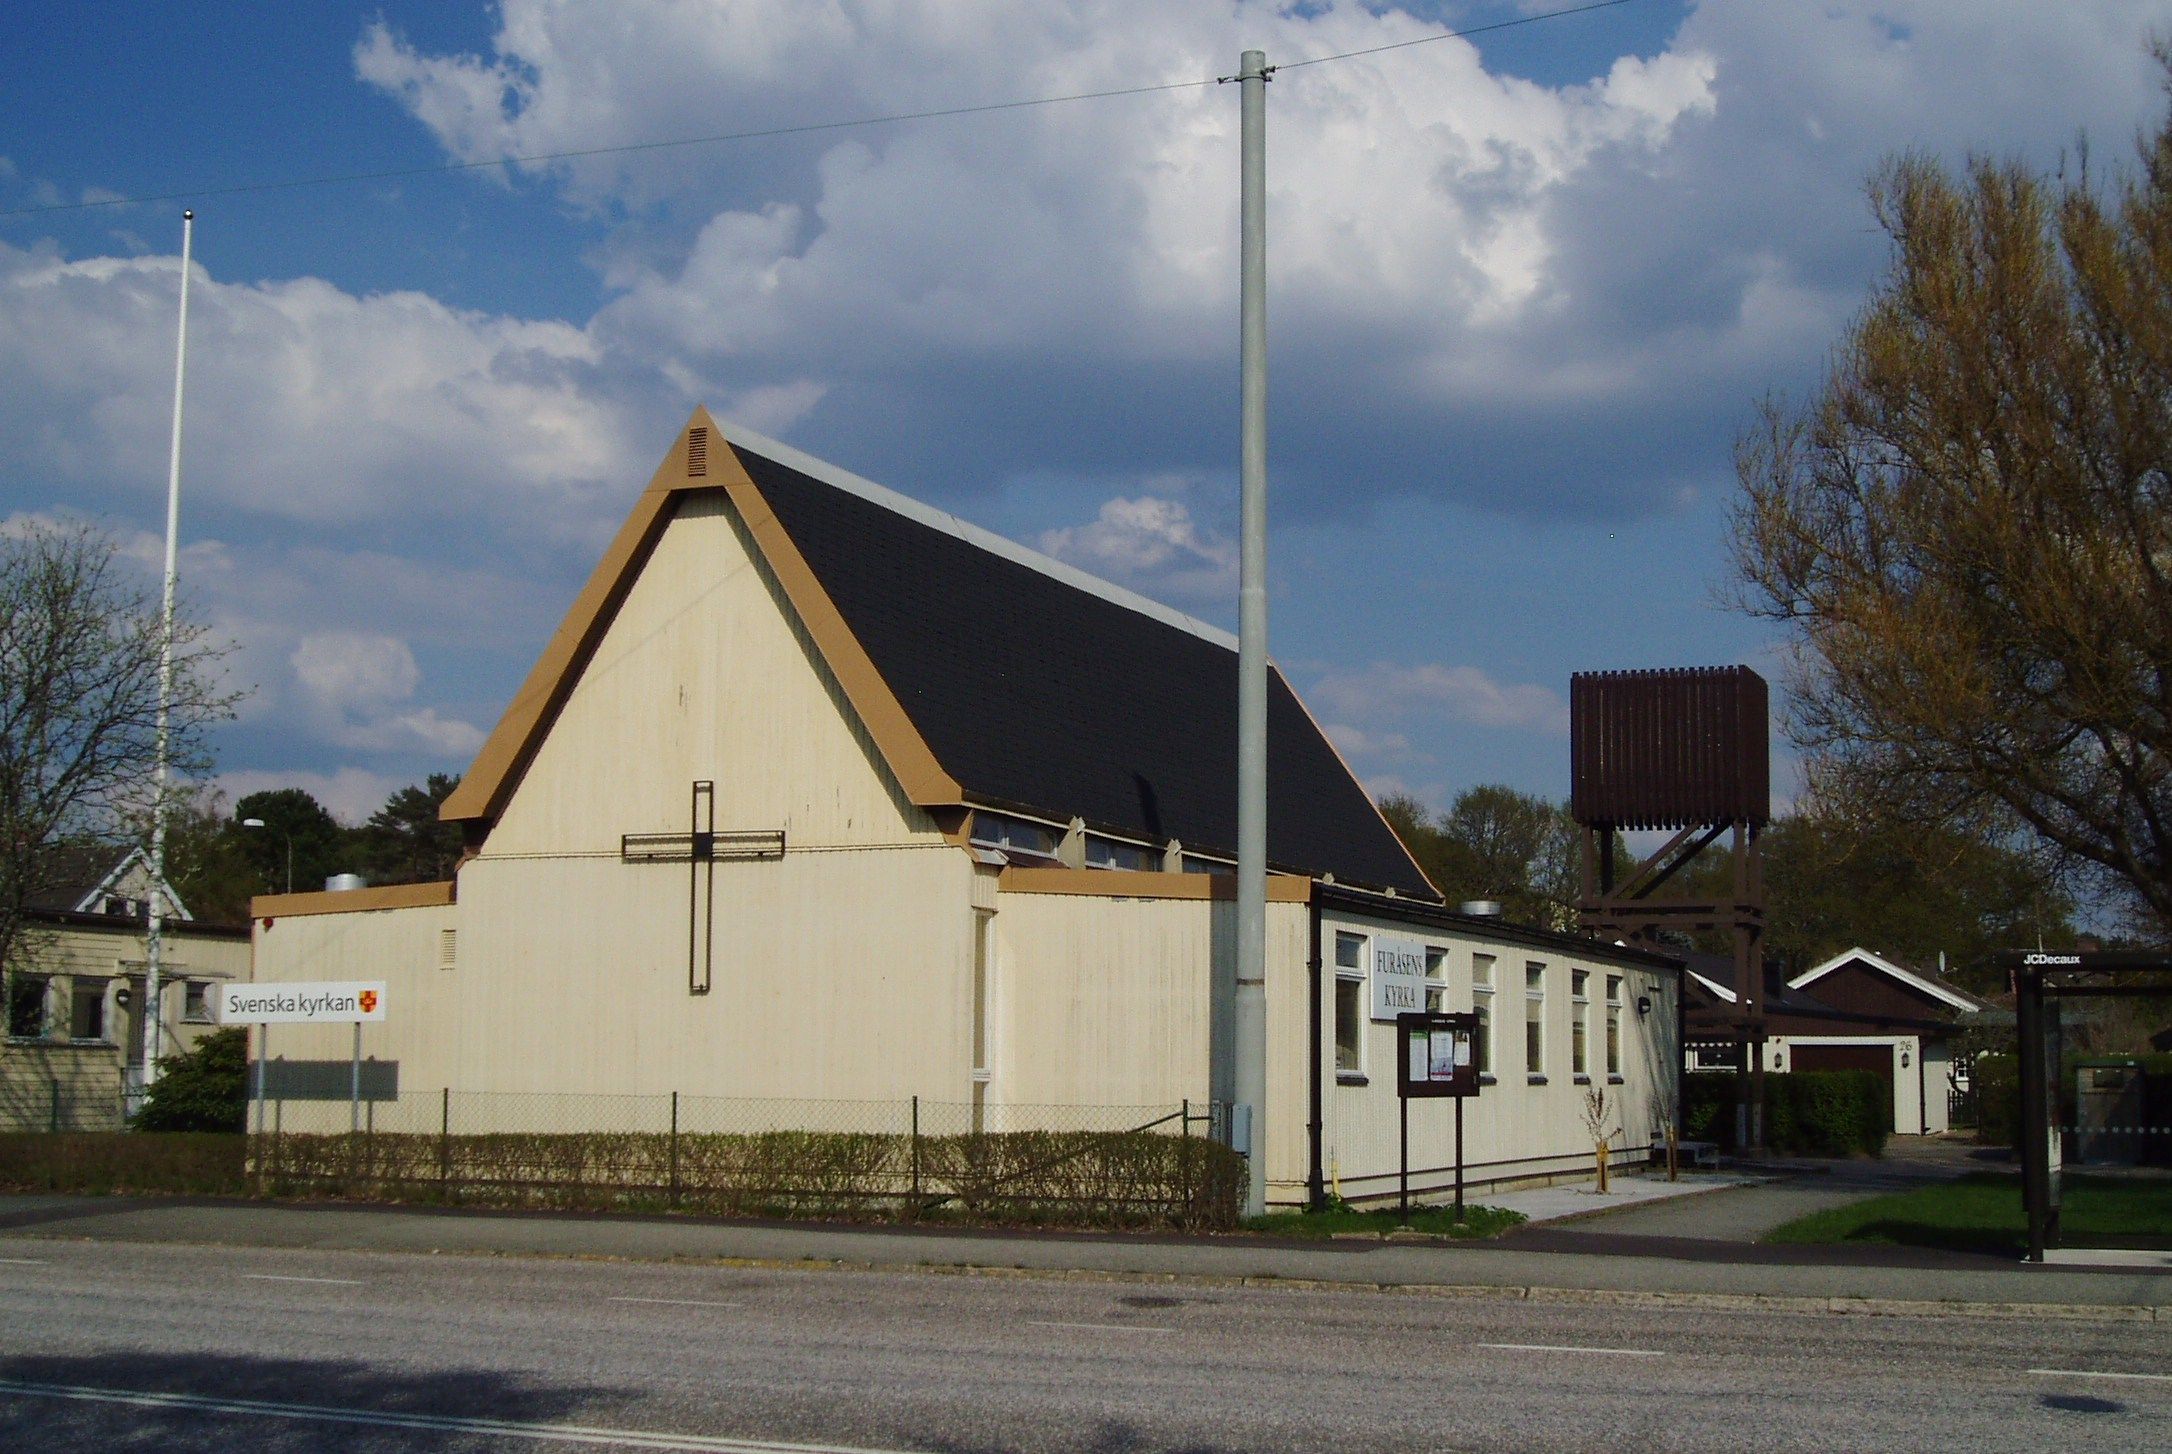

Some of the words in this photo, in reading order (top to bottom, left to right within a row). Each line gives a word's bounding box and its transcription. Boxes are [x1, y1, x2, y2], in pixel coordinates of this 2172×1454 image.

[1377, 946, 1423, 977] FURÅSENS
[2023, 954, 2081, 965] JCDecaux
[229, 993, 295, 1013] Svenska
[298, 992, 354, 1016] kyrkan
[1384, 984, 1416, 1008] KYRKA
